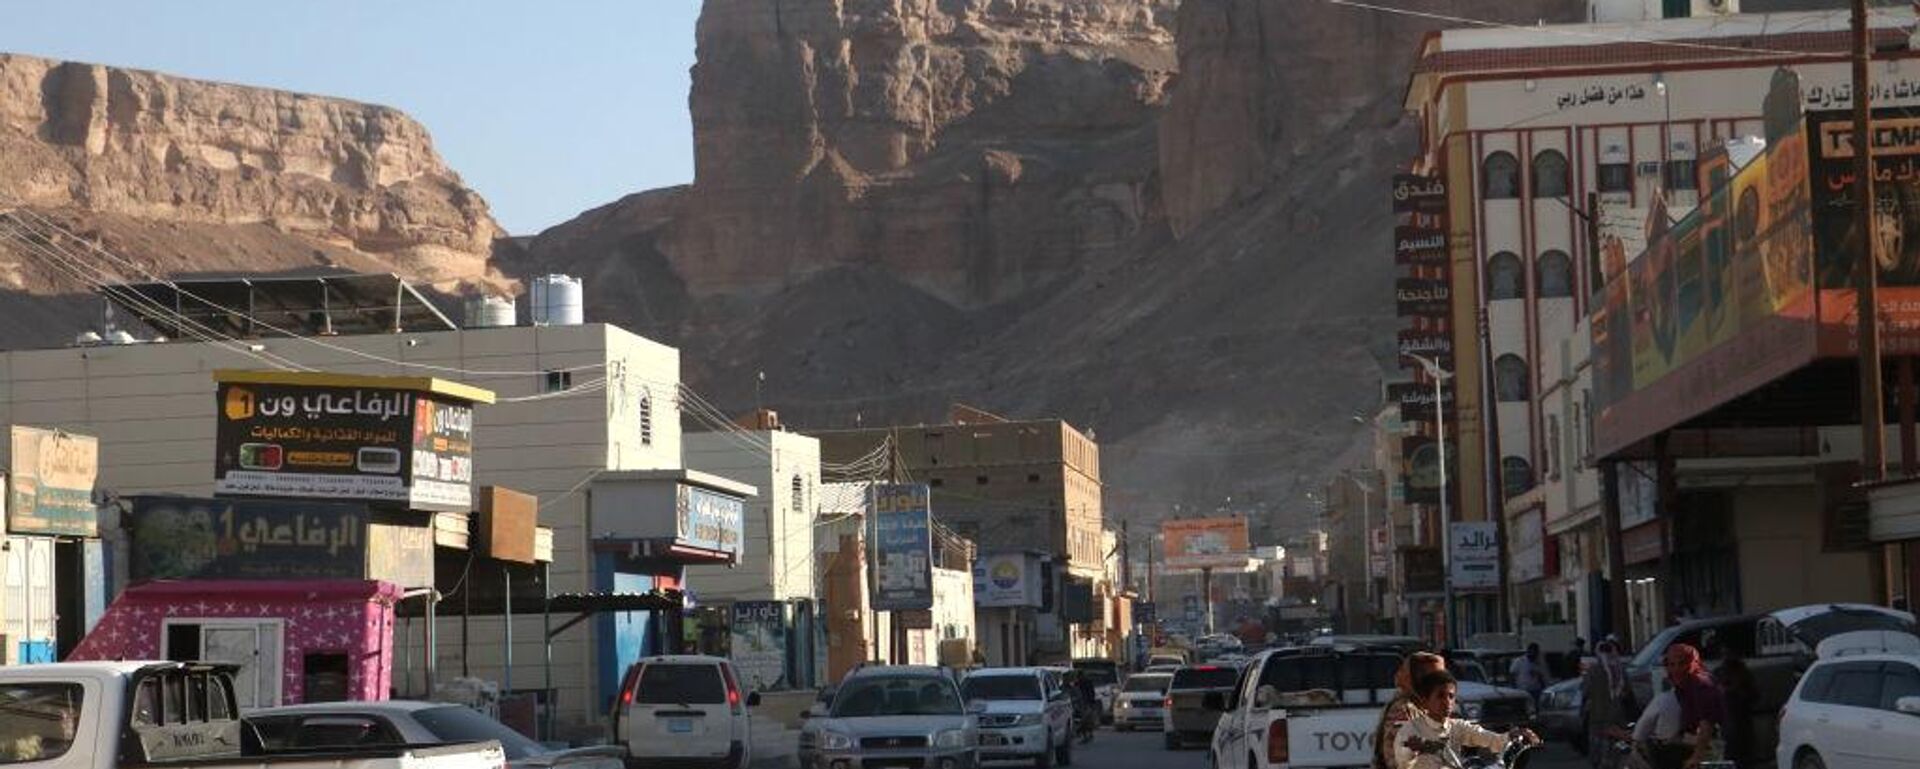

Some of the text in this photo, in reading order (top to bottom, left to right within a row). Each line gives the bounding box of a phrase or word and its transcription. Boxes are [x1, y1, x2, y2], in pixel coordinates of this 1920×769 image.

[1557, 84, 1645, 110] هذا من فضل ربي
[1394, 180, 1445, 200] فندق
[1397, 234, 1445, 253] النسيم
[259, 396, 296, 418] ون
[303, 390, 411, 421] الرفاعي
[240, 510, 359, 558] الرفاعي
